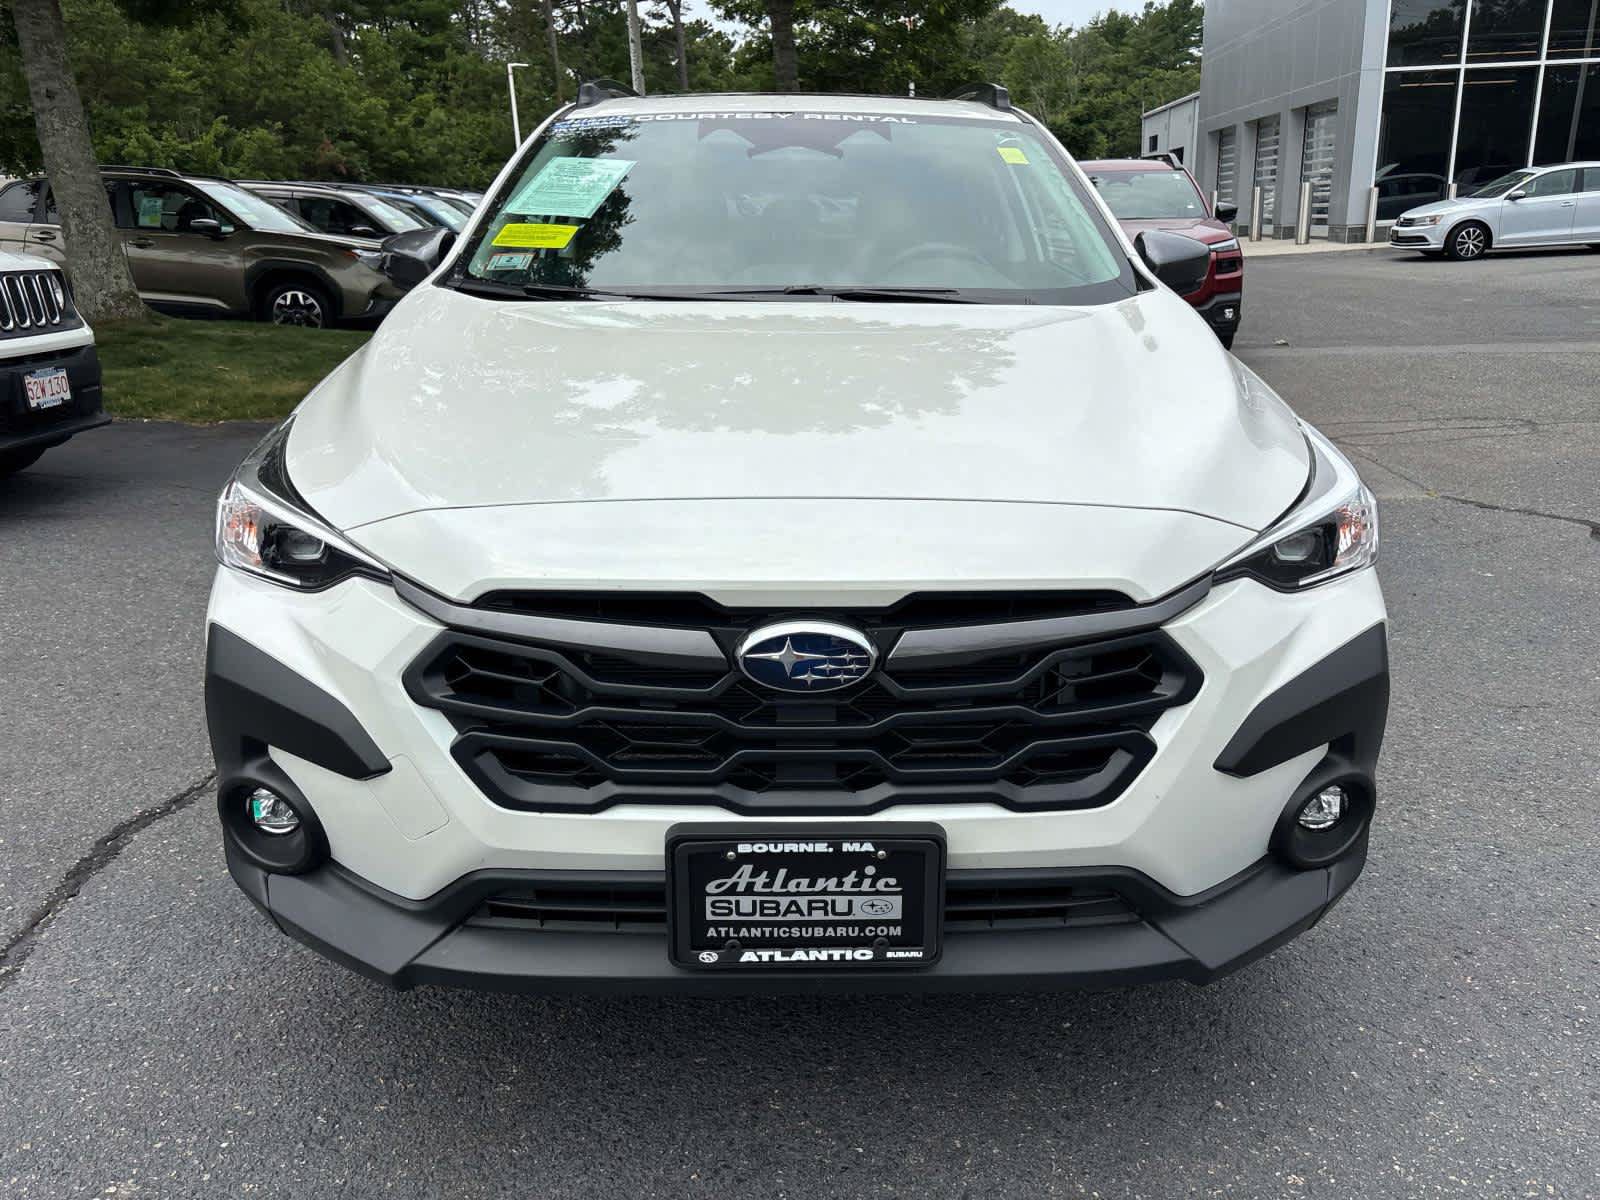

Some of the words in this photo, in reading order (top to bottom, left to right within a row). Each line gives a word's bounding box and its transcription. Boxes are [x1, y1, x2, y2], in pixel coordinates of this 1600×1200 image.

[803, 112, 917, 124] RENTAL
[48, 375, 68, 397] 130
[842, 842, 875, 853] MA
[705, 864, 903, 894] Atlantic
[710, 898, 853, 917] SUBARU
[706, 926, 902, 938] ATLANTICSUBARU.COM
[738, 949, 874, 963] ATLANTIC
